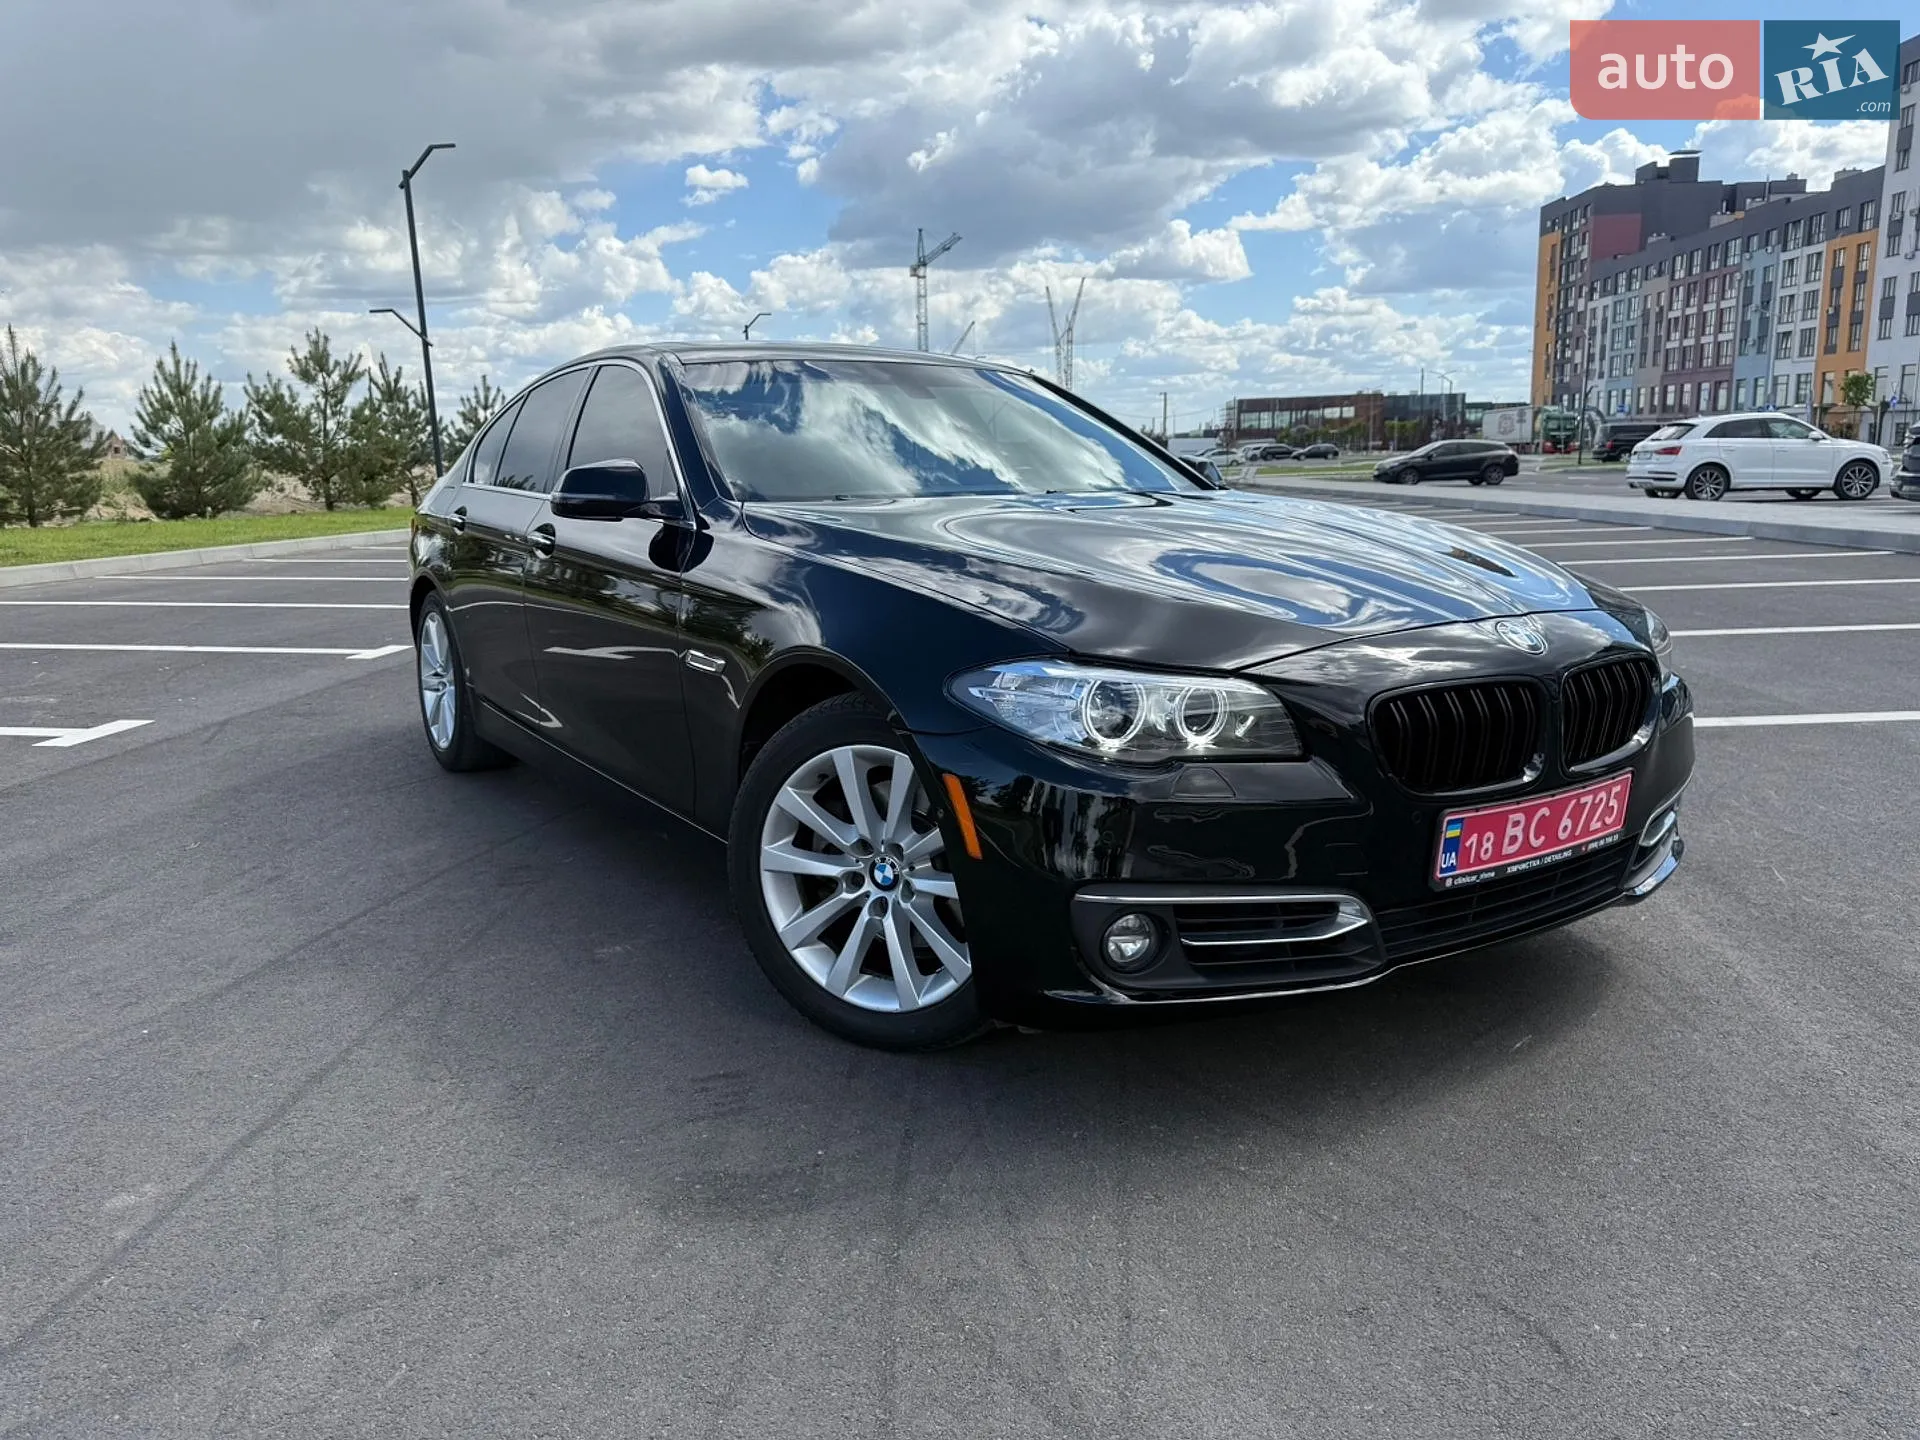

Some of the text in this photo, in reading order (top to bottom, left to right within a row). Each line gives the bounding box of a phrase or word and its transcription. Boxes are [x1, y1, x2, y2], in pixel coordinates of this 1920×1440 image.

[1465, 785, 1621, 864] 18 BC 6725
[1441, 852, 1457, 869] UA
